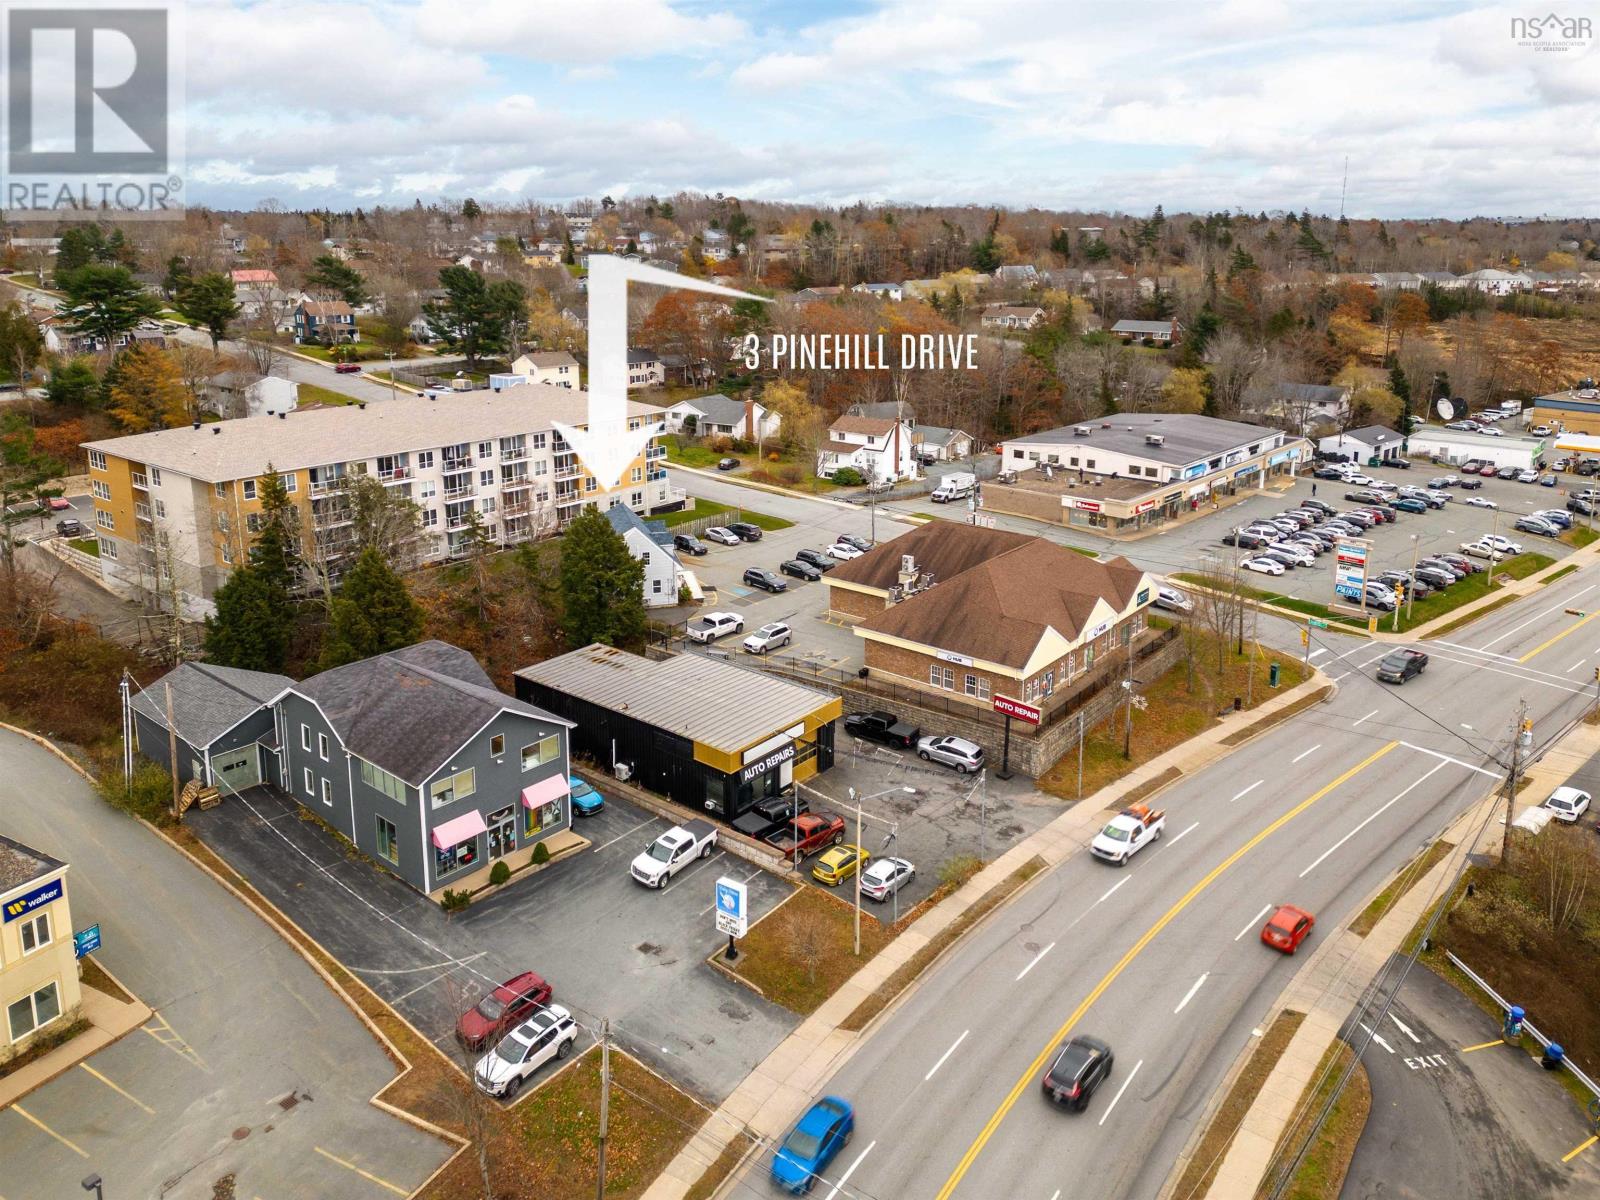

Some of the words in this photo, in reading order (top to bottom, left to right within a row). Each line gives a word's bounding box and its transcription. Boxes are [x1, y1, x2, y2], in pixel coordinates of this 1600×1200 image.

[994, 700, 1014, 712] AUTO
[1014, 706, 1039, 721] REPAIR
[744, 762, 766, 781] AUTO
[766, 746, 795, 769] REPAIRS
[28, 888, 58, 907] walker
[1403, 1054, 1448, 1070] EXIT
